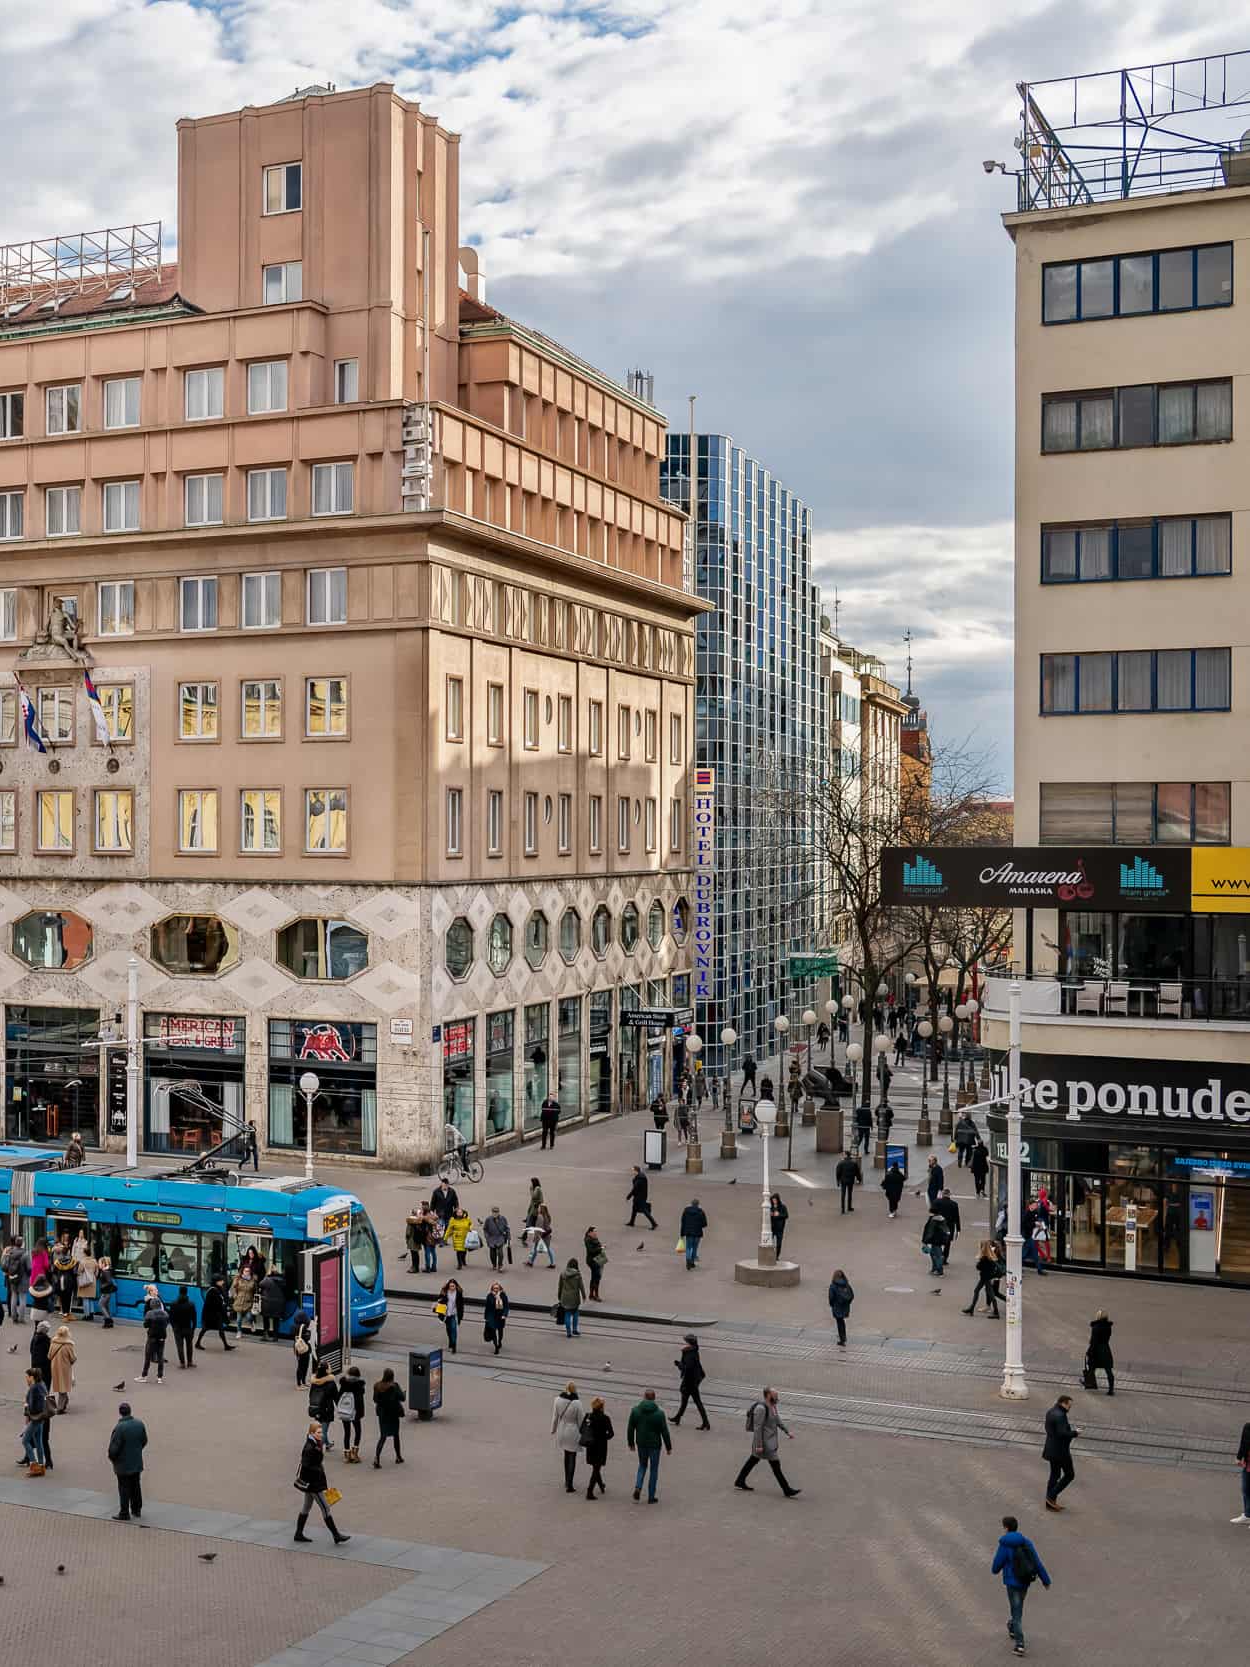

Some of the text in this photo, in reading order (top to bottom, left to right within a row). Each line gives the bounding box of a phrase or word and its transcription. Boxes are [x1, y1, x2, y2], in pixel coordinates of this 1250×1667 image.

[695, 798, 711, 865] HOTEL
[979, 862, 1083, 884] Amarena
[1009, 887, 1053, 895] MARASKA
[695, 874, 711, 996] DUBROVNIK
[160, 1017, 236, 1034] AMERICAN
[1066, 1079, 1250, 1122] ponude
